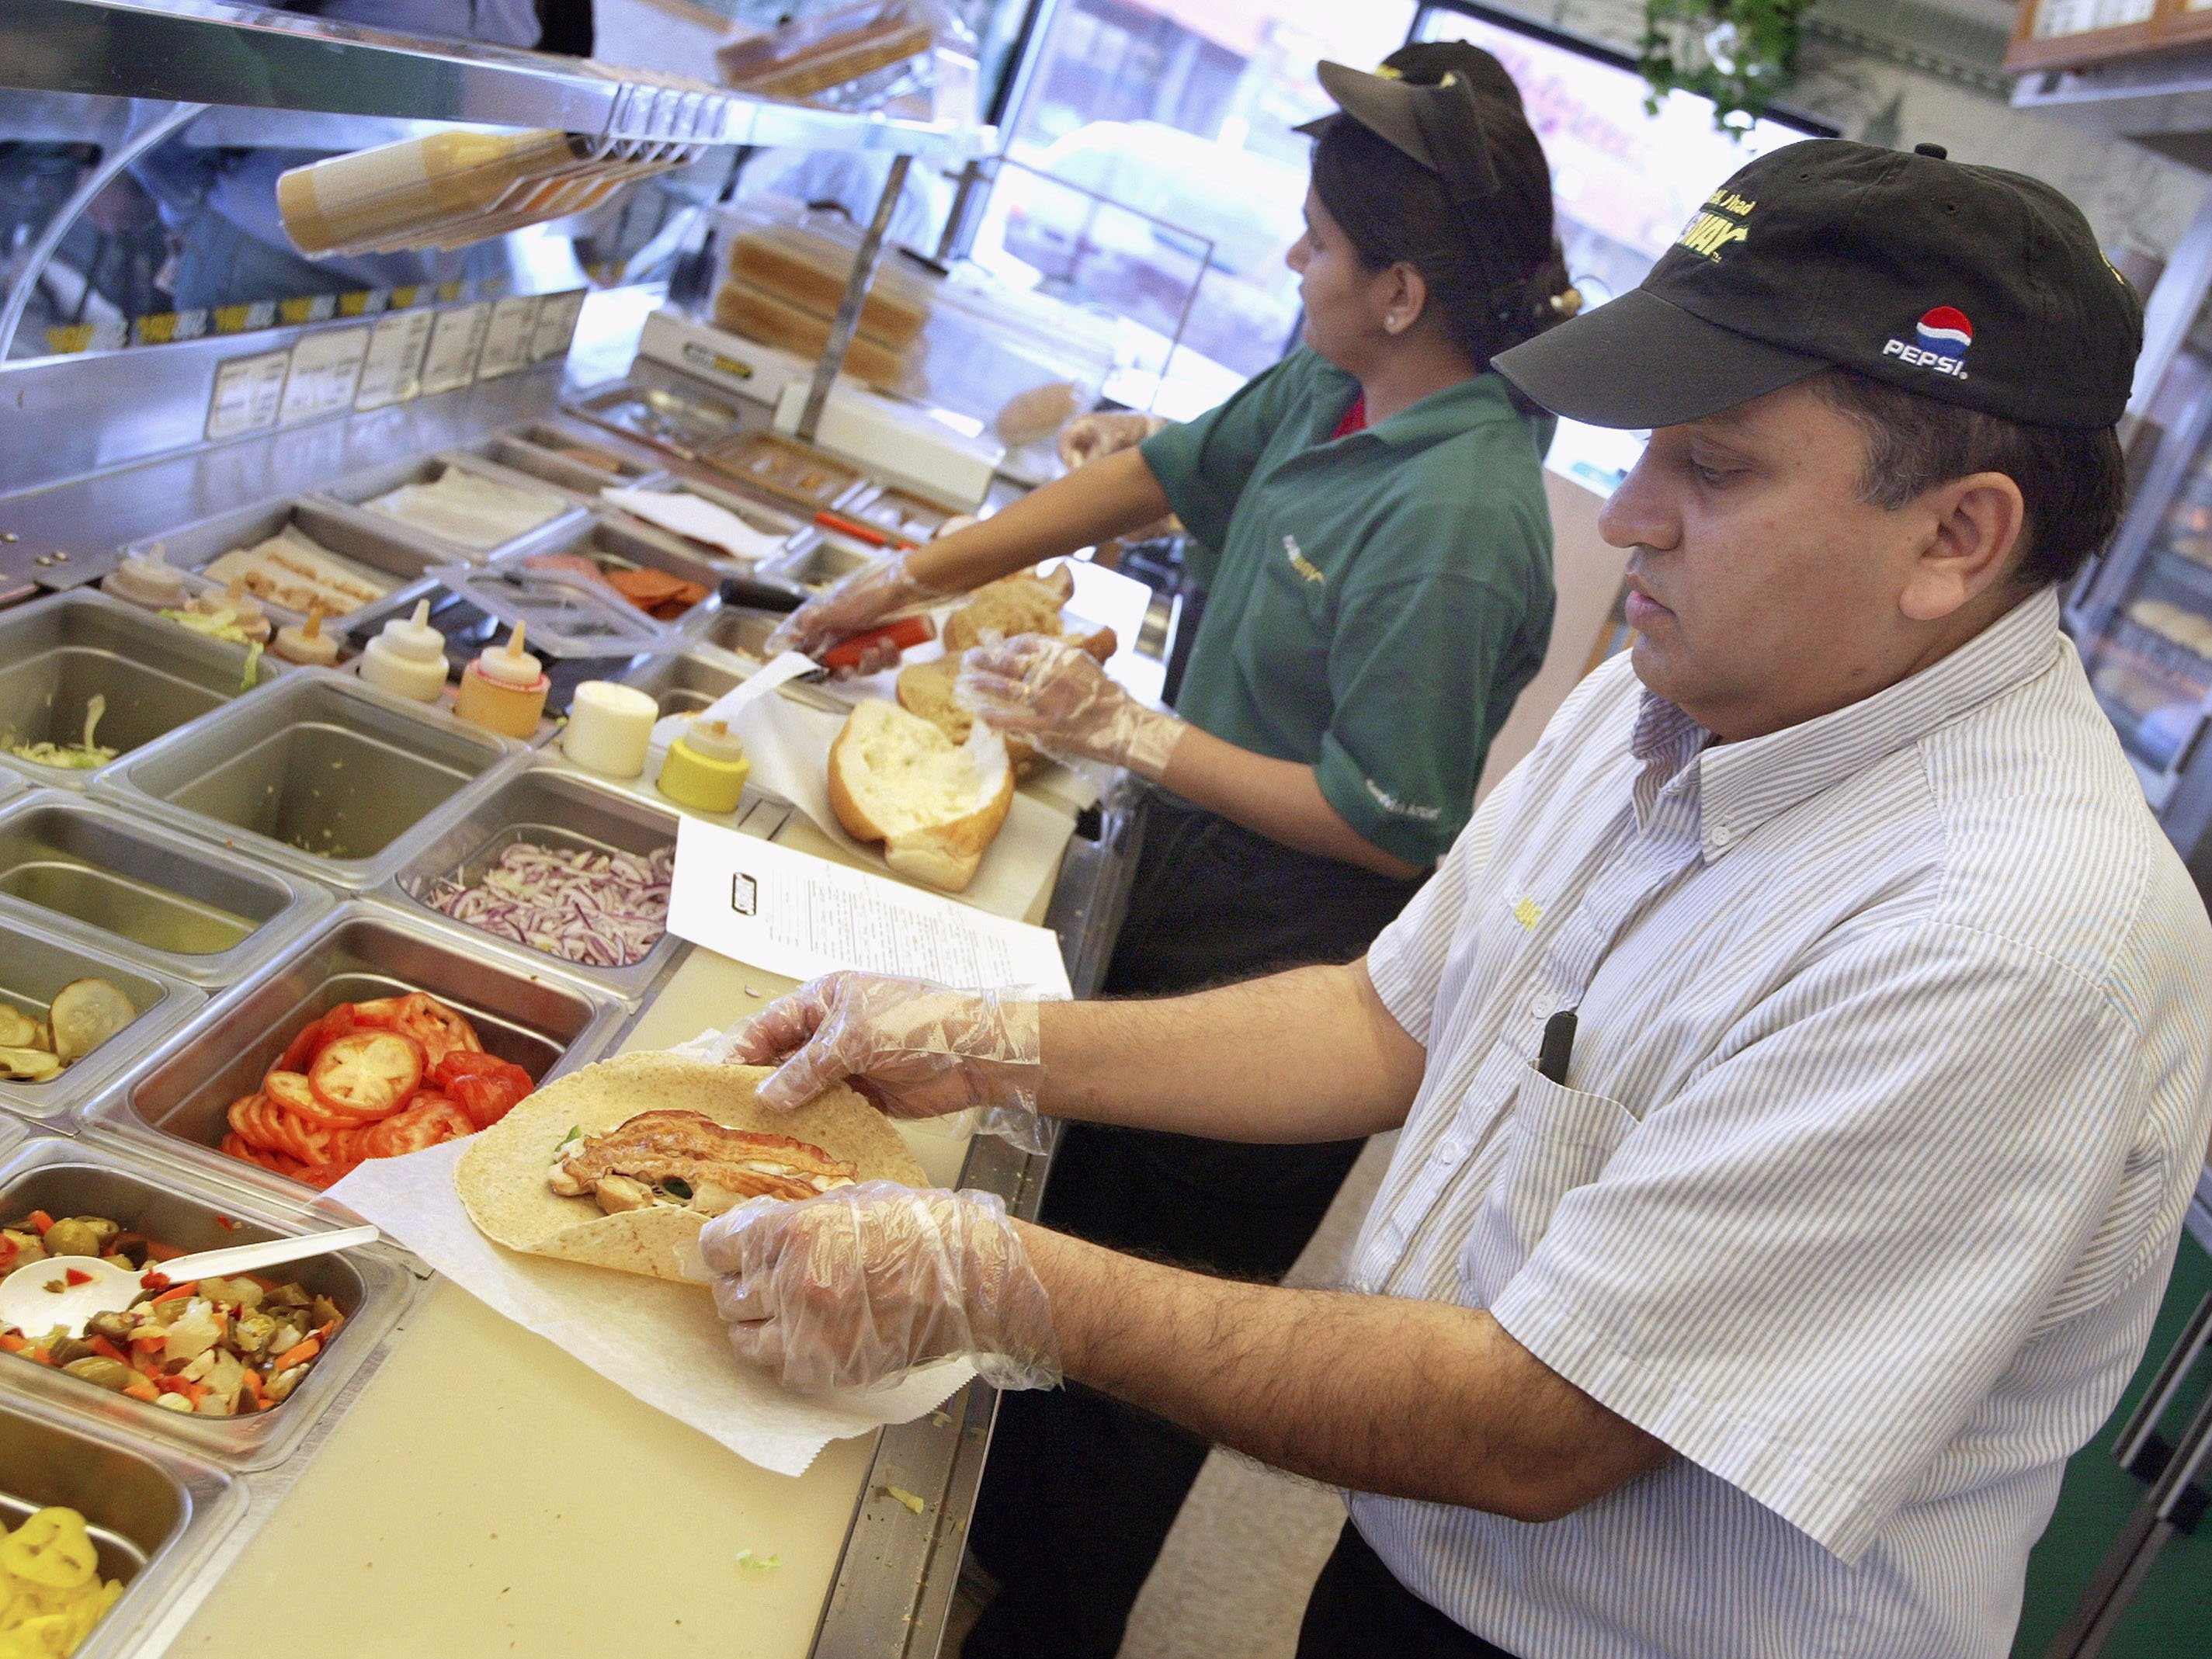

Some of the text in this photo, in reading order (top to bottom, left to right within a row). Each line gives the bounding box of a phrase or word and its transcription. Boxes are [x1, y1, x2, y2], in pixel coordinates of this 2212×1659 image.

[1726, 194, 1756, 216] had
[1677, 210, 1748, 256] WAY
[1883, 339, 1964, 377] PEPSI
